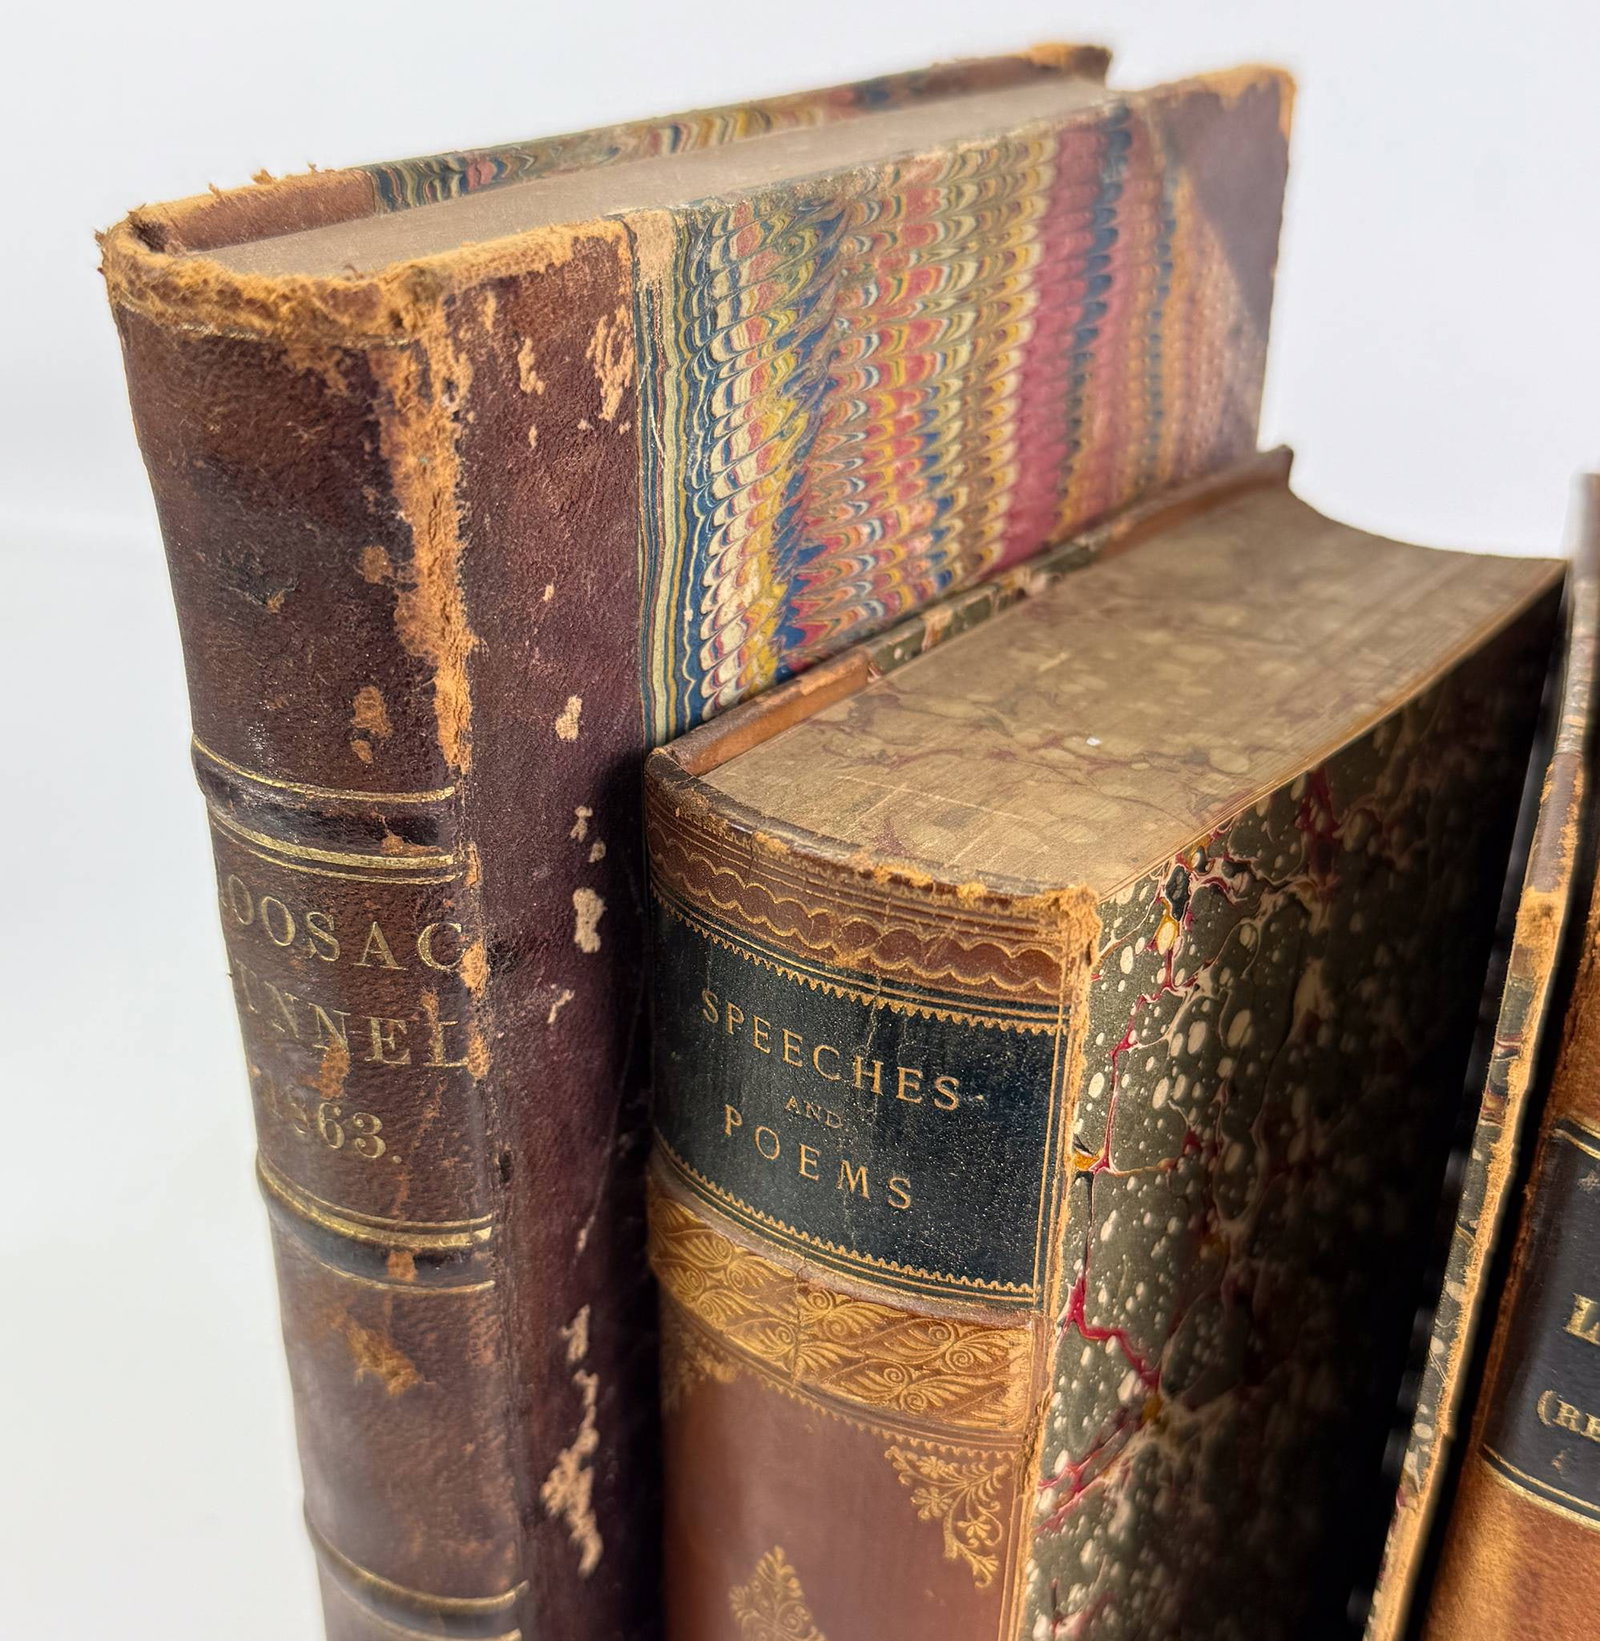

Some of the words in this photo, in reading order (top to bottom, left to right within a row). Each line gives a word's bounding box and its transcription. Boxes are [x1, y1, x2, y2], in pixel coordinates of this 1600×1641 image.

[221, 873, 467, 972] OOSAC
[701, 989, 961, 1111] SPEECHES
[723, 1104, 912, 1210] POEMS
[784, 1095, 845, 1129] AND
